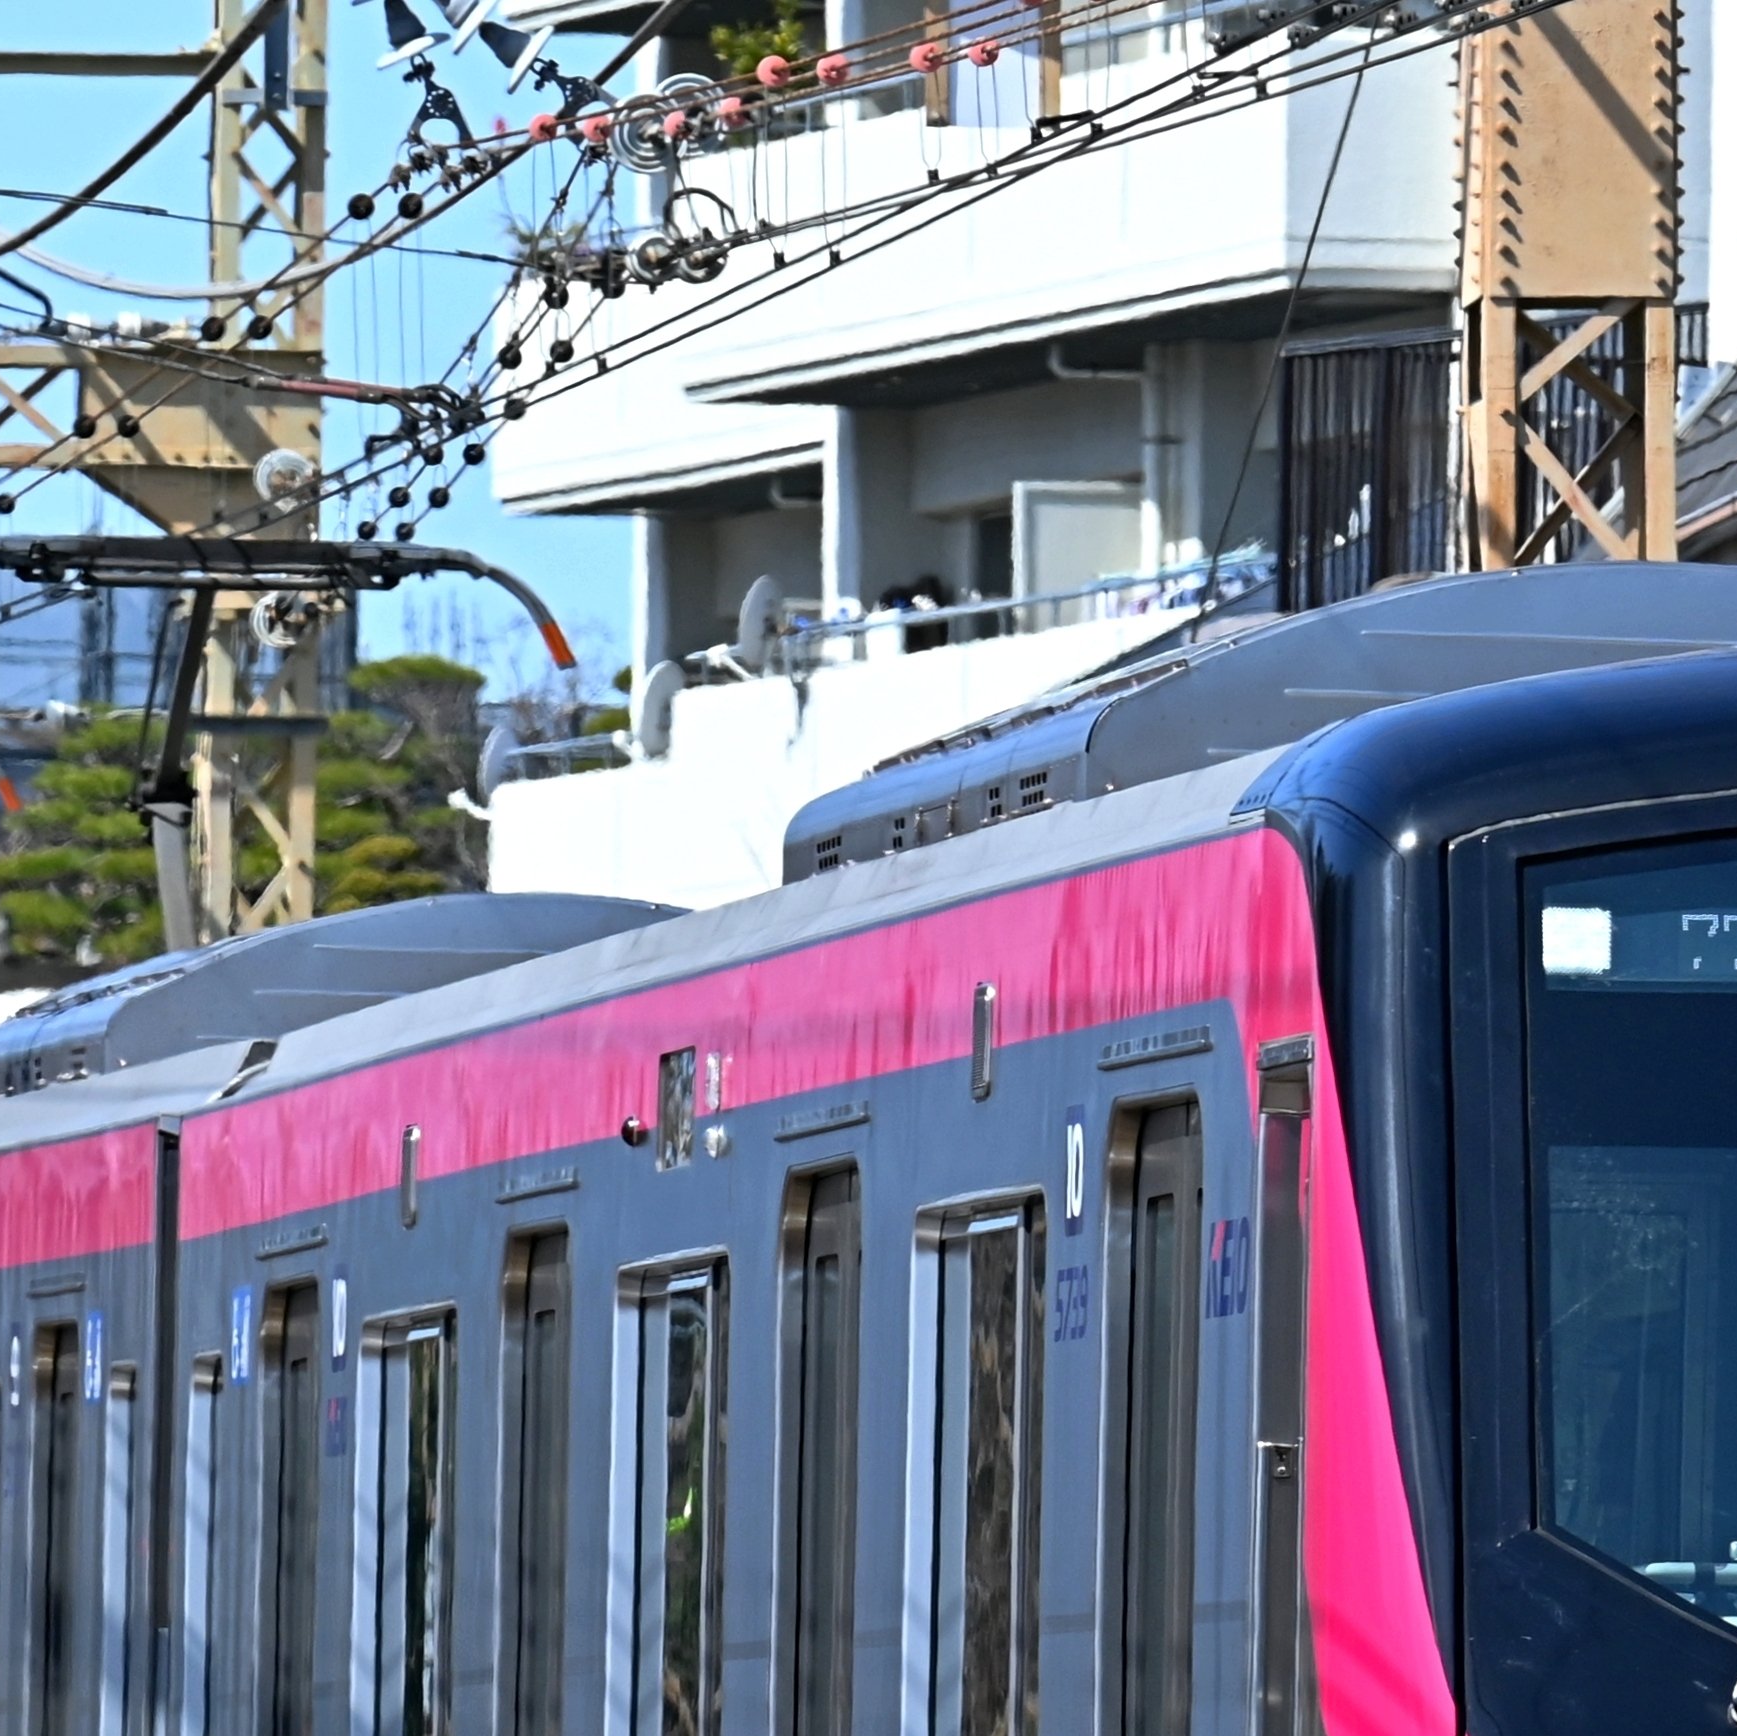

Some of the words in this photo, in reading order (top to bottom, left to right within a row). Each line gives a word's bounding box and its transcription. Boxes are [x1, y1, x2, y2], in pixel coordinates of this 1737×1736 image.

[1066, 1122, 1084, 1219] 10
[1054, 1265, 1089, 1343] 5739
[1205, 1216, 1250, 1320] KEIO
